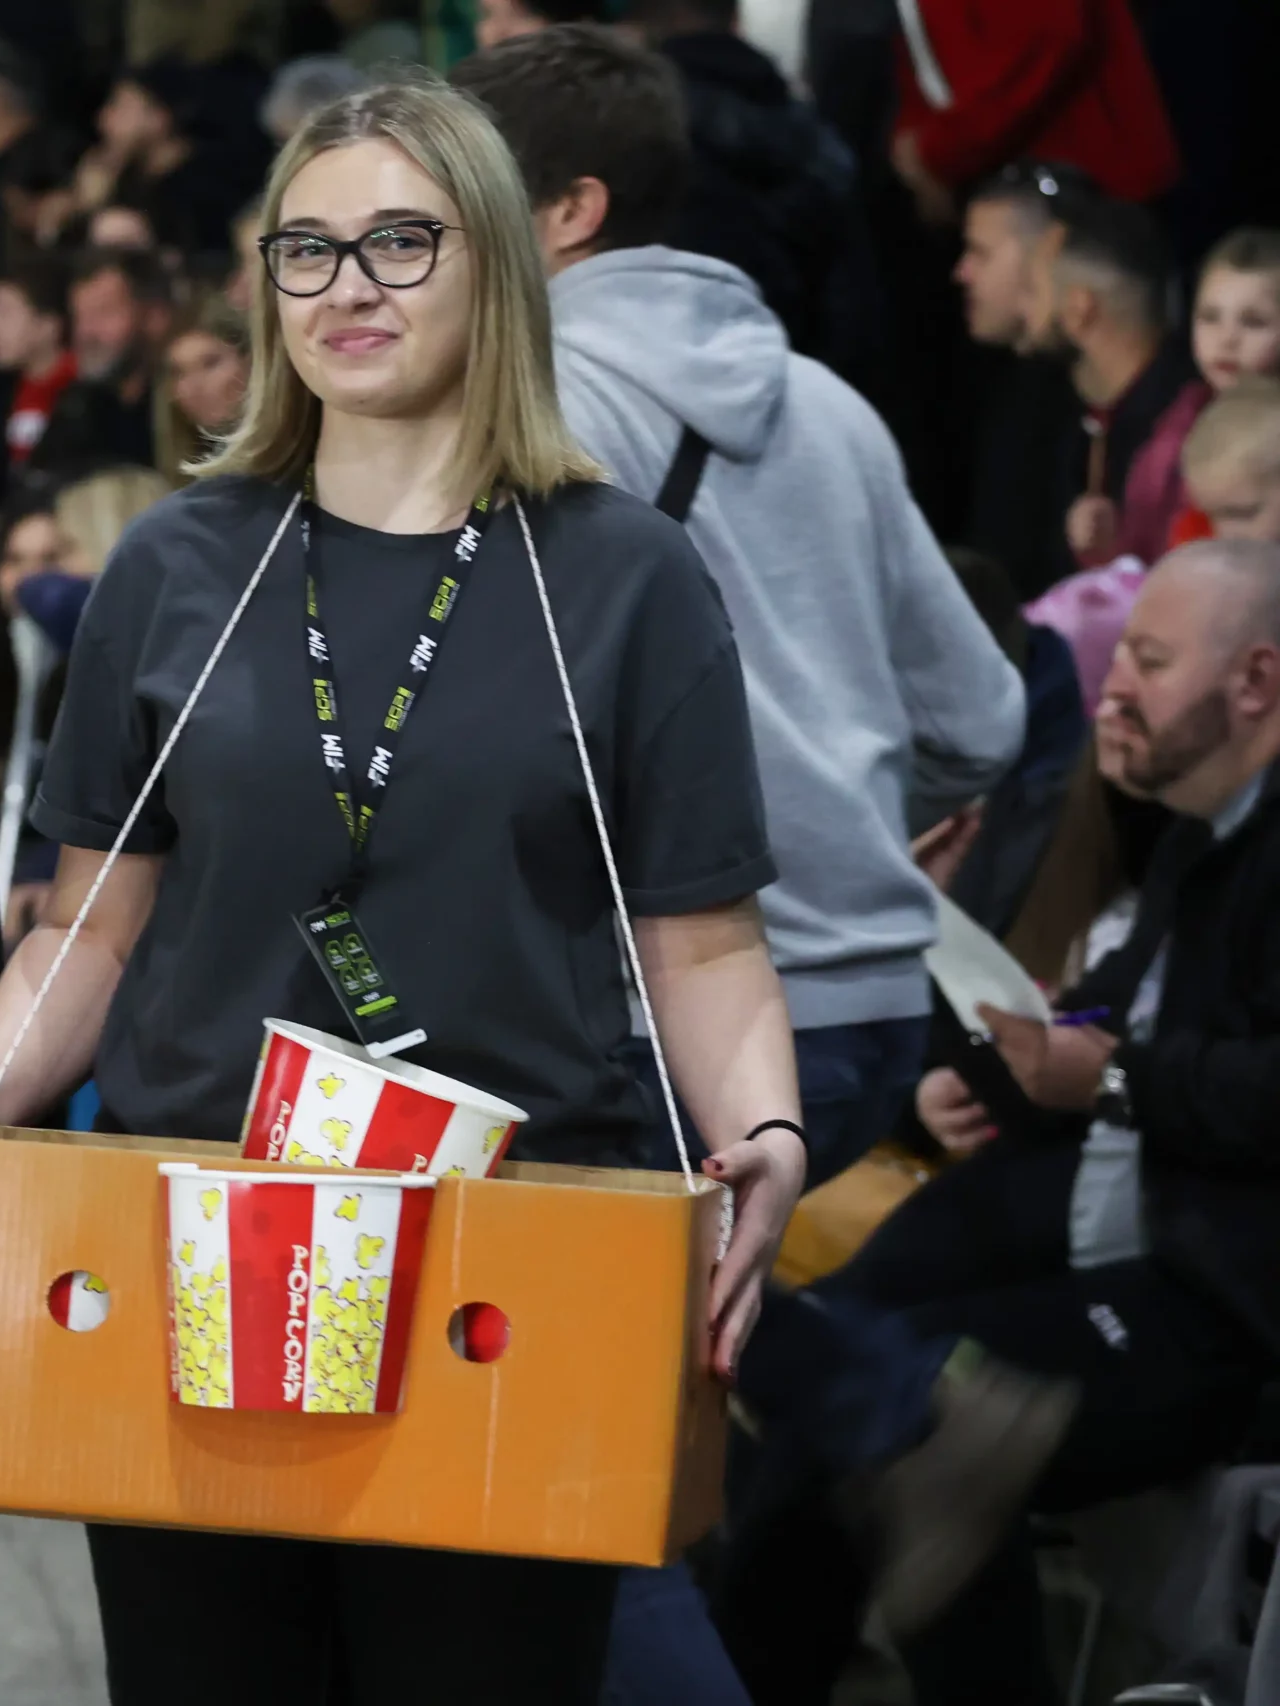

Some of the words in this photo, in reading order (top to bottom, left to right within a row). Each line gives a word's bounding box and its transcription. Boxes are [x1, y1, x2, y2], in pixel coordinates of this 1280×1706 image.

[455, 525, 482, 562] FIM
[409, 634, 437, 673] FIM
[307, 627, 330, 662] FIM
[320, 734, 345, 772] FIM
[367, 746, 393, 787] FIM
[282, 1244, 309, 1403] POPCORN
